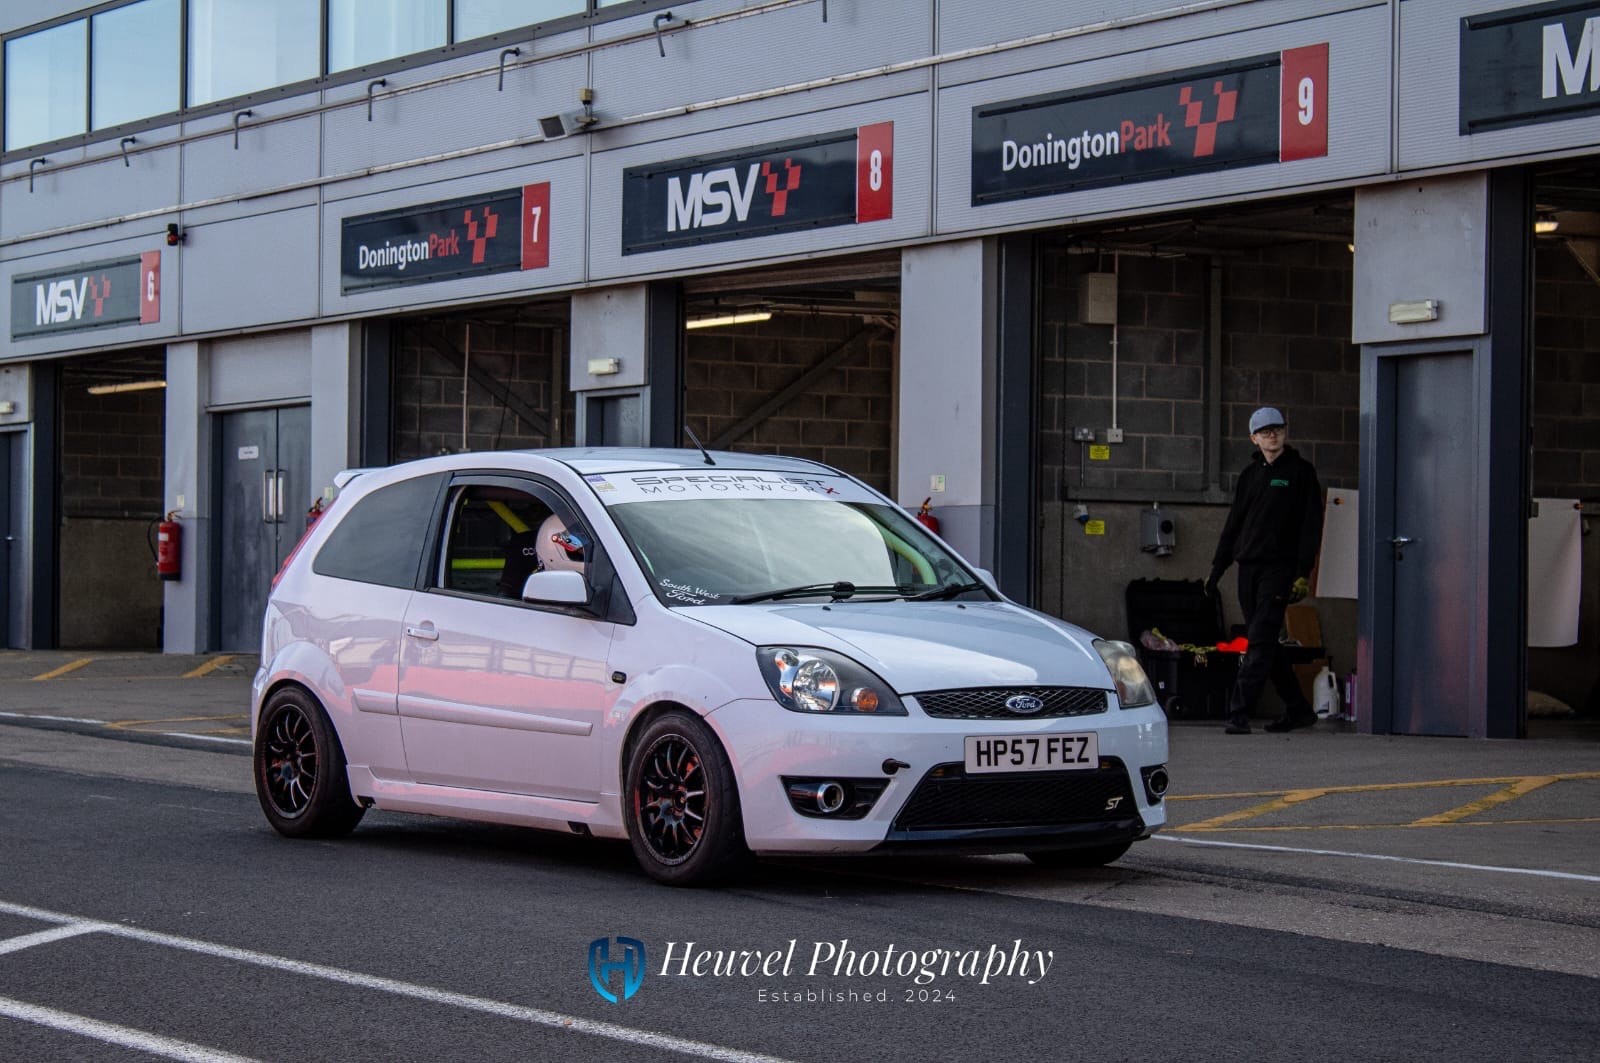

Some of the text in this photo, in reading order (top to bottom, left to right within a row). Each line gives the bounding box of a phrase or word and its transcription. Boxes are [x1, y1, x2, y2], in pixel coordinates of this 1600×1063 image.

[1298, 77, 1314, 125] 9
[870, 149, 883, 192] 8
[667, 163, 760, 232] MSV
[531, 206, 542, 243] 7
[35, 276, 89, 326] MSV
[147, 271, 155, 302] 6
[631, 476, 826, 486] SPECIALIST
[660, 578, 720, 600] South West
[666, 590, 706, 605] Ford
[1015, 698, 1036, 710] Ford
[976, 737, 1089, 767] HP57 FEZ
[1105, 796, 1123, 810] ST
